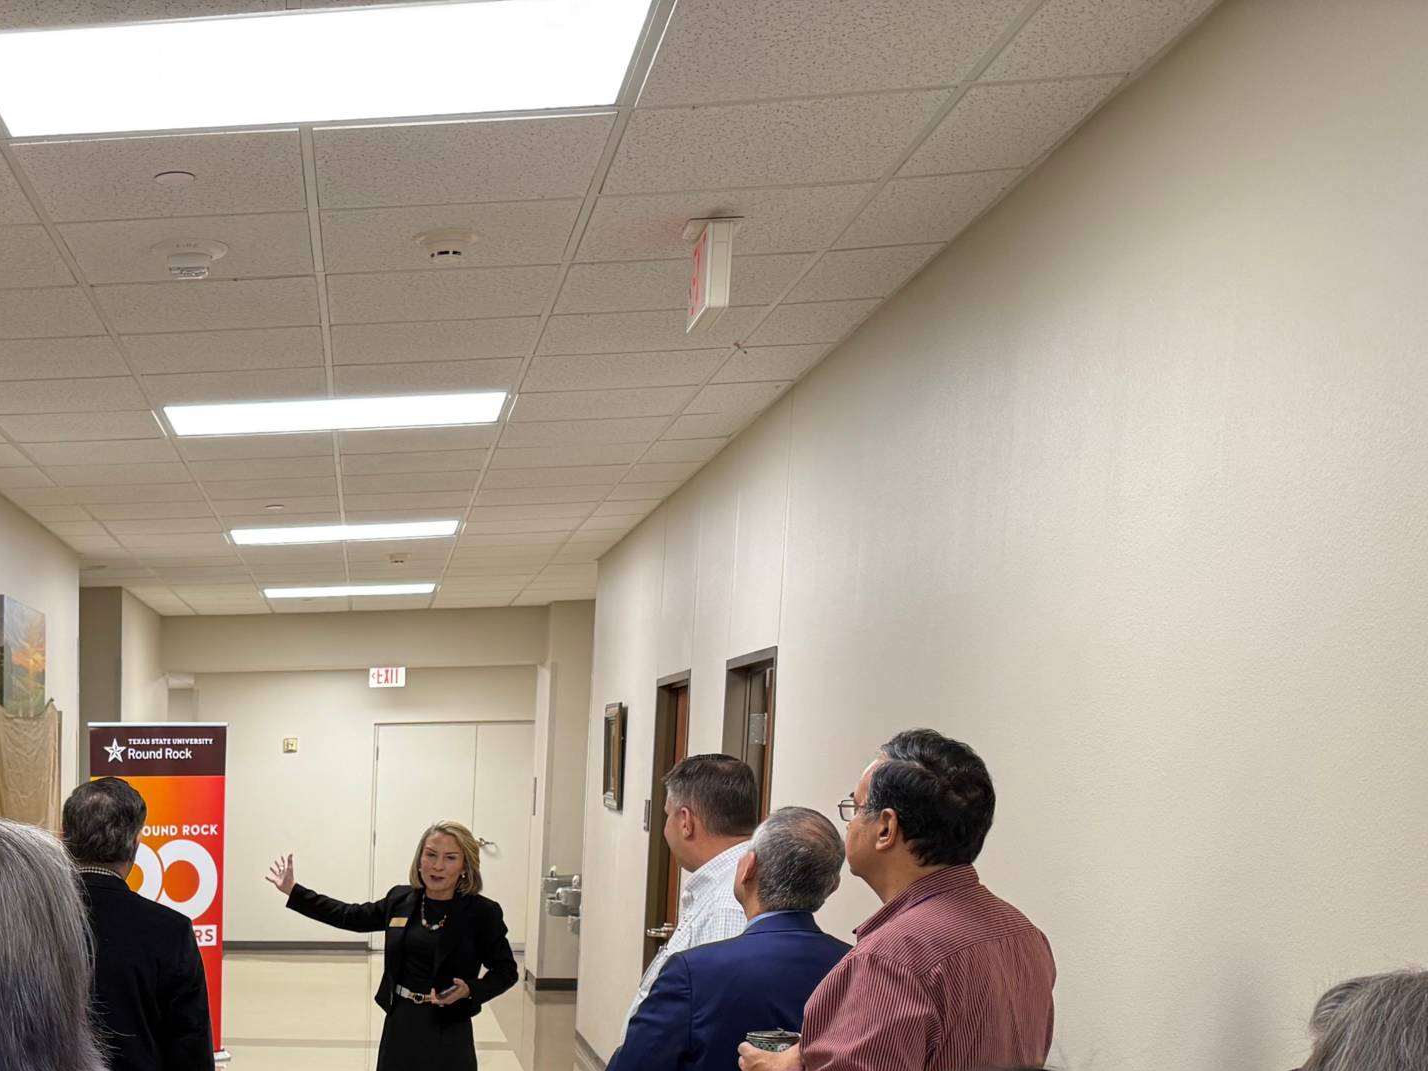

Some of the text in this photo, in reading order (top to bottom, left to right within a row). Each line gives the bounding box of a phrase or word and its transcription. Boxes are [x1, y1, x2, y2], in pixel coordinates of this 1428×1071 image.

[376, 668, 398, 684] EXIT
[128, 747, 193, 760] Round Rock
[142, 824, 219, 837] OUND ROCK
